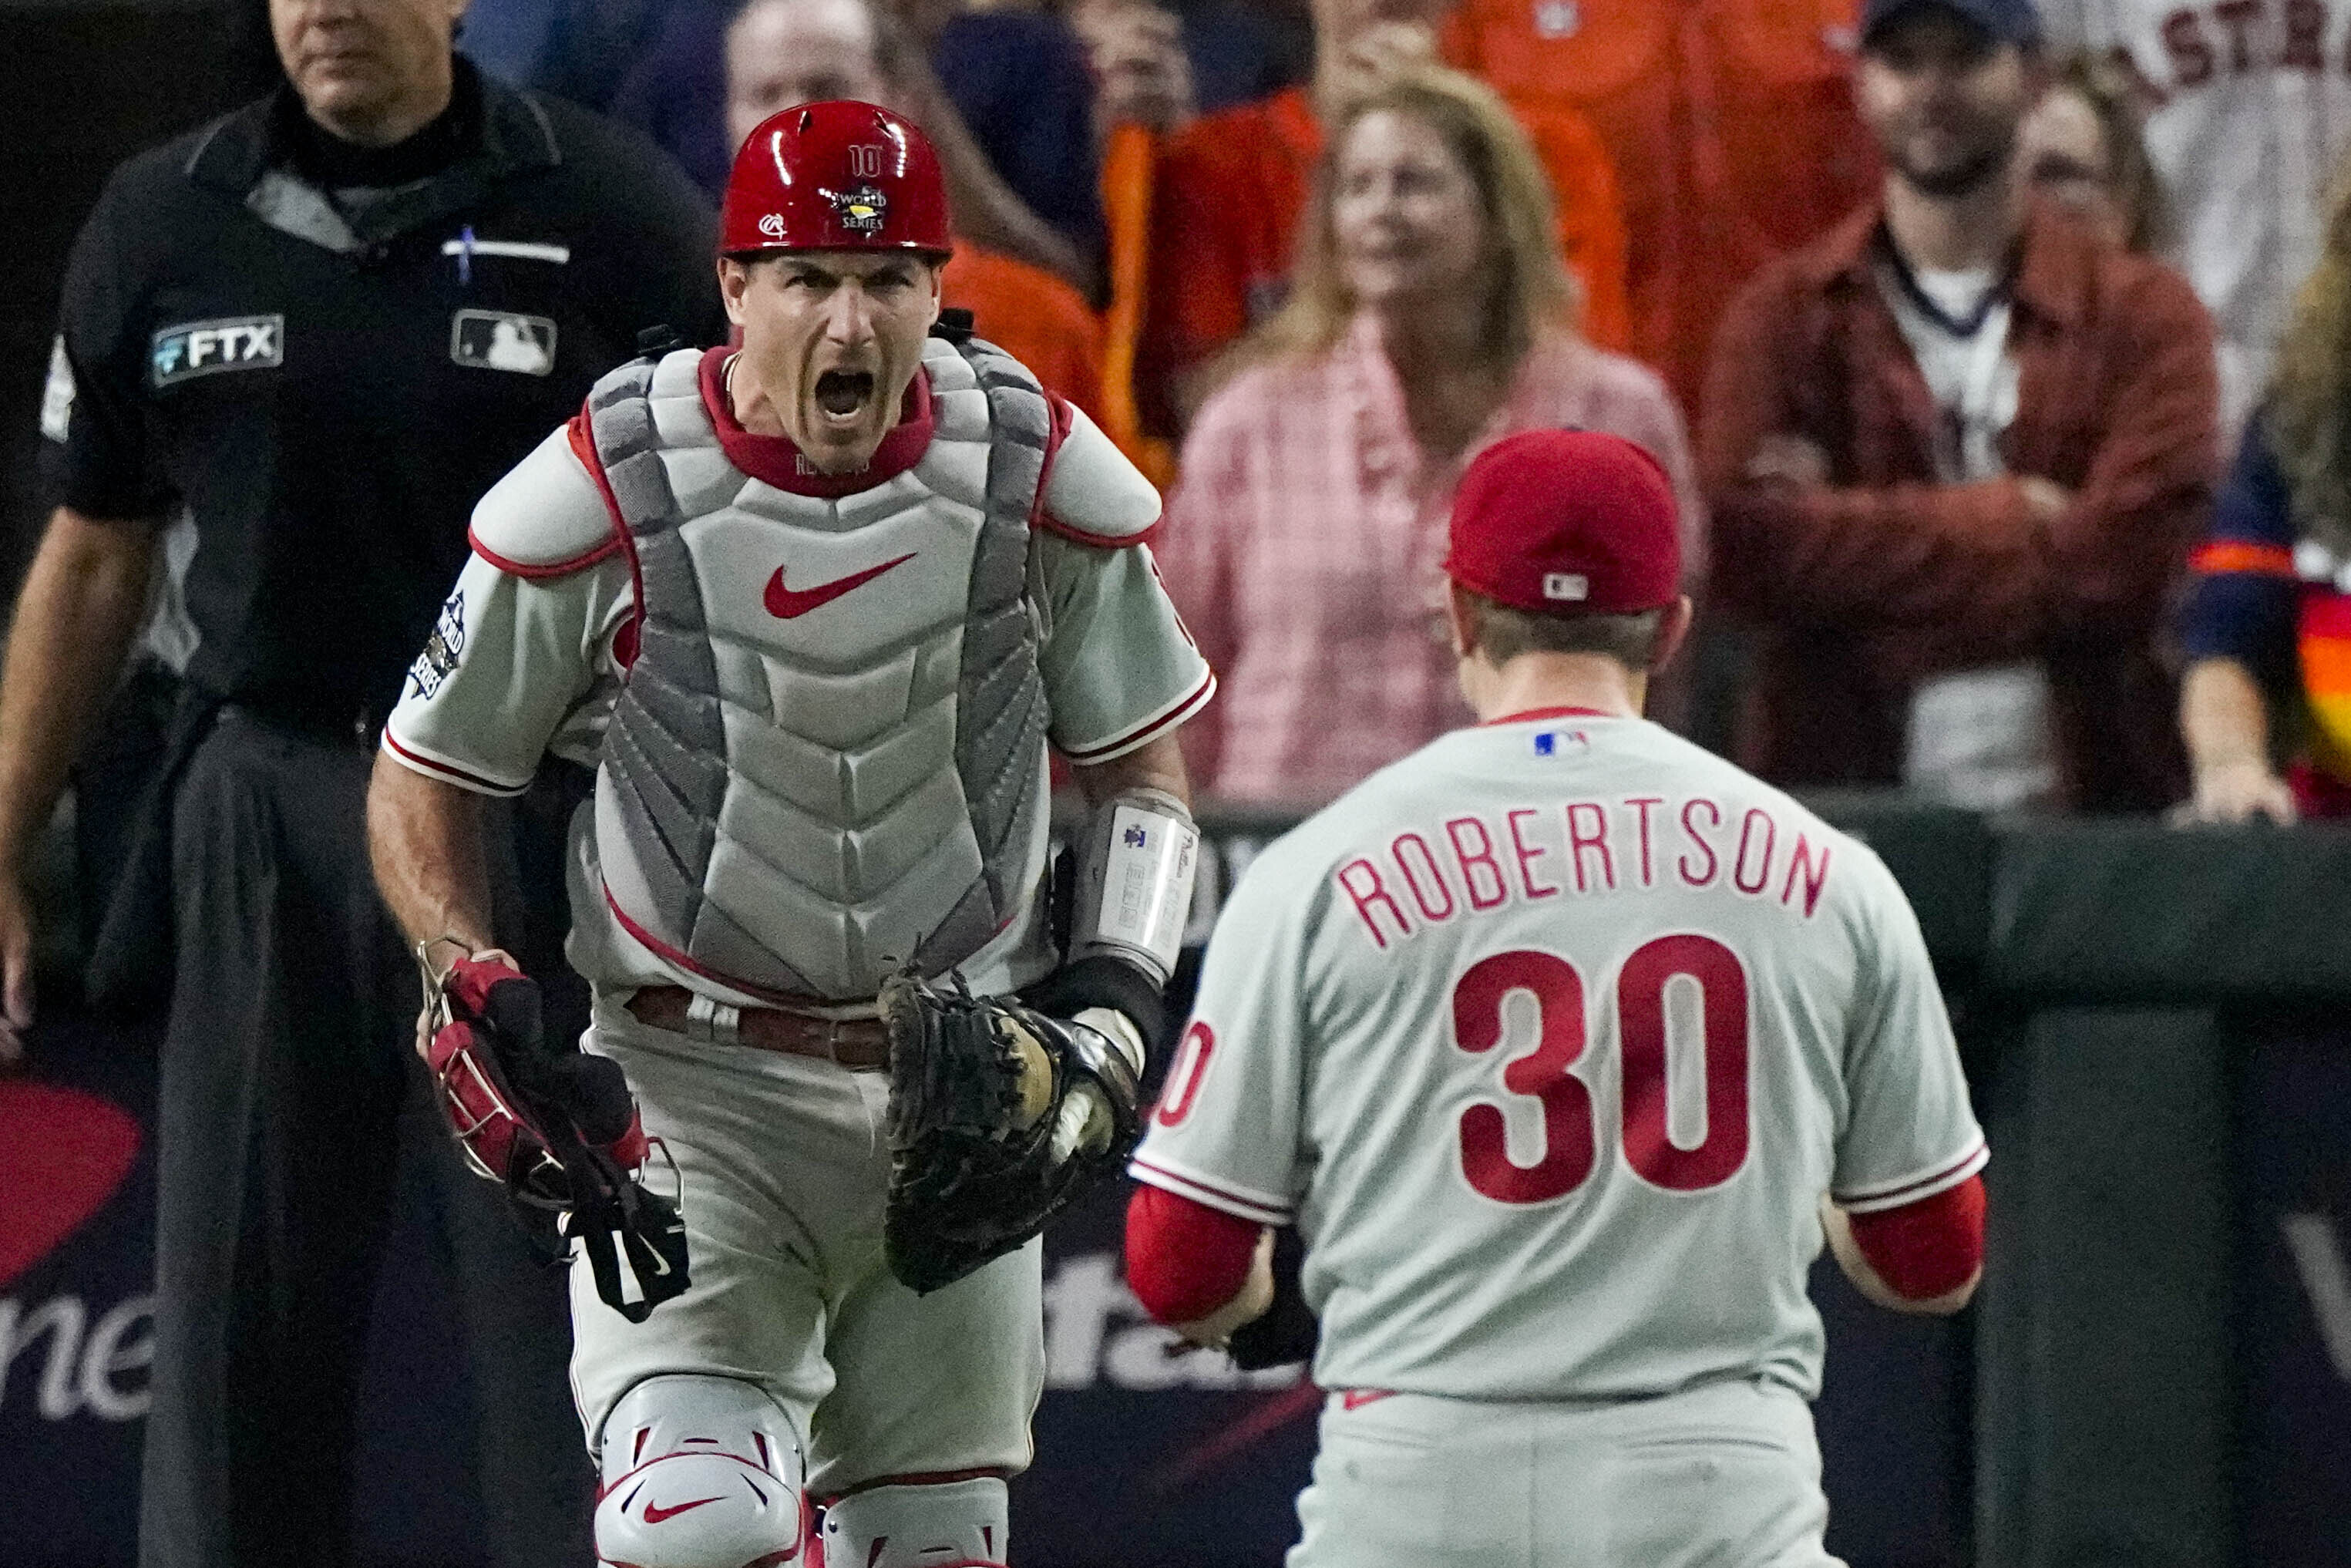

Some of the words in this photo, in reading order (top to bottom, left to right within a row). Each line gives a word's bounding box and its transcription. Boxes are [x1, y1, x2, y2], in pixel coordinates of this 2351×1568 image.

[849, 145, 883, 177] 10
[839, 193, 887, 207] WORLD
[842, 217, 884, 230] SERIES
[189, 325, 274, 368] FTX
[436, 604, 464, 655] WORLD
[409, 652, 442, 698] SERIES
[1337, 796, 1832, 949] ROBERTSON
[1452, 933, 1750, 1204] 30
